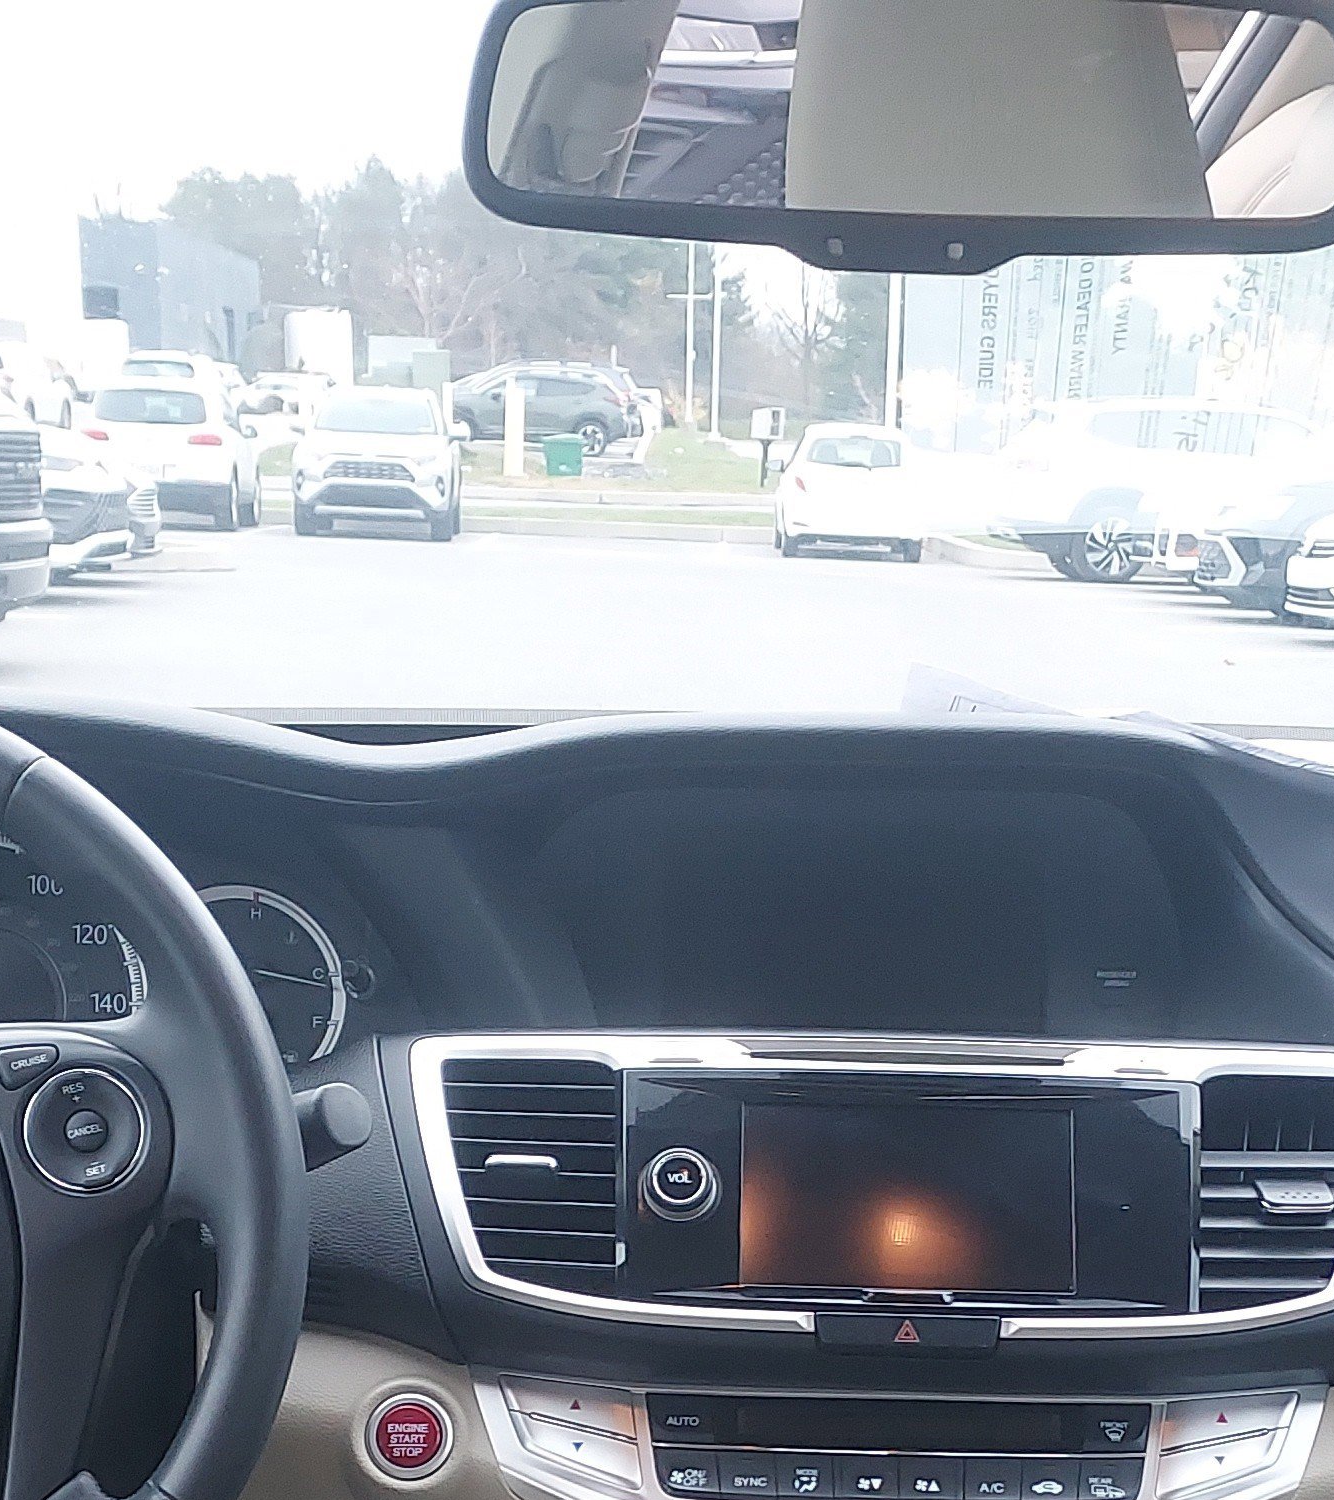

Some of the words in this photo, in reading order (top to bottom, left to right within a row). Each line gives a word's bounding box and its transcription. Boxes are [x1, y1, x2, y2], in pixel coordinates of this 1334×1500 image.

[250, 908, 262, 920] H
[73, 924, 108, 945] 120
[312, 967, 325, 980] C
[90, 994, 127, 1014] 140
[312, 1016, 323, 1029] F
[10, 1053, 49, 1071] CRUISE
[62, 1082, 85, 1095] RES
[67, 1123, 104, 1140] CANCEL
[85, 1163, 106, 1177] SET
[667, 1170, 693, 1184] VOL
[666, 1416, 699, 1427] AUTO
[387, 1423, 429, 1434] ENGINE
[390, 1434, 426, 1444] START
[392, 1447, 424, 1458] STOP
[683, 1477, 707, 1487] OFF
[734, 1477, 767, 1487] SYNC
[979, 1482, 1005, 1494] A/C
